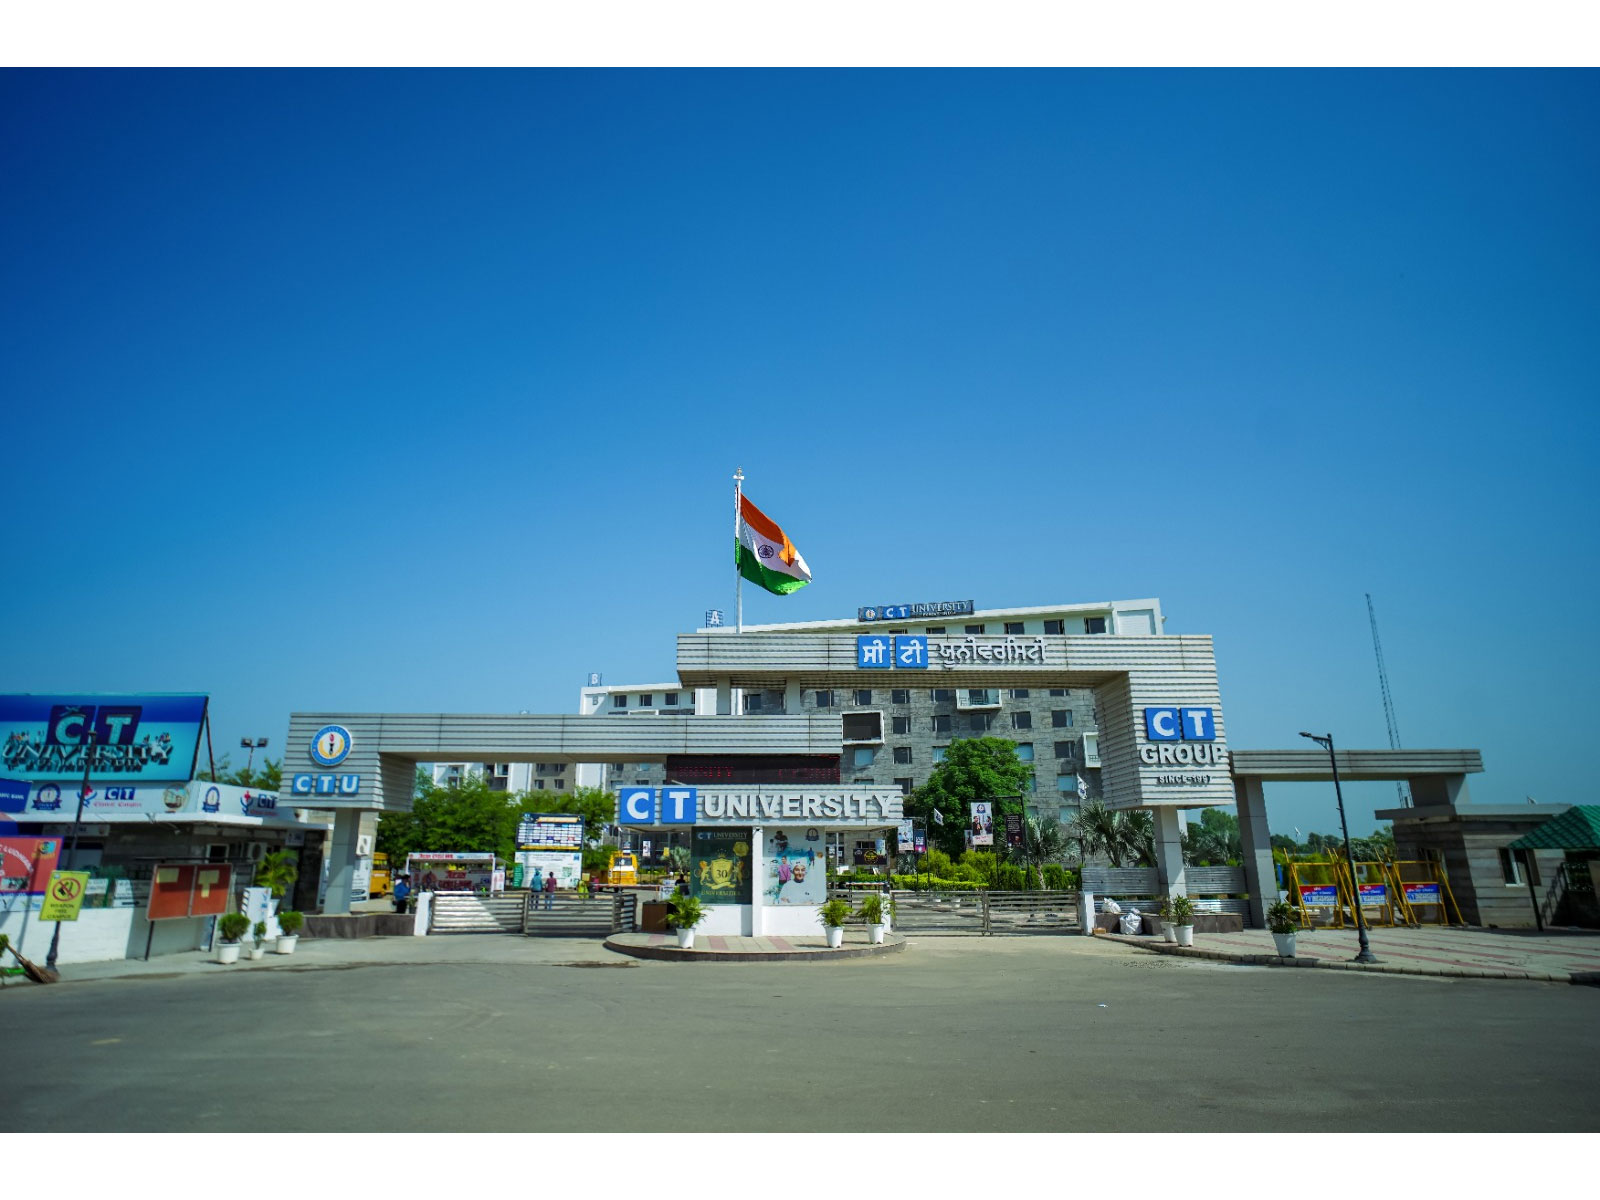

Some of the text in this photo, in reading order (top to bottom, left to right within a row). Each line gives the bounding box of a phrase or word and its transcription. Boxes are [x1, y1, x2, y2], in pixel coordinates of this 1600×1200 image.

[911, 602, 969, 612] UNIVERSITY
[711, 611, 720, 625] A
[862, 639, 887, 664] ਸੀ
[900, 639, 924, 664] ਟੀ
[2, 744, 172, 759] UNIVERSITY
[1140, 743, 1228, 764] GROUP
[296, 775, 358, 793] CTU
[704, 794, 895, 818] UNIVERSITY
[716, 869, 728, 879] 30
